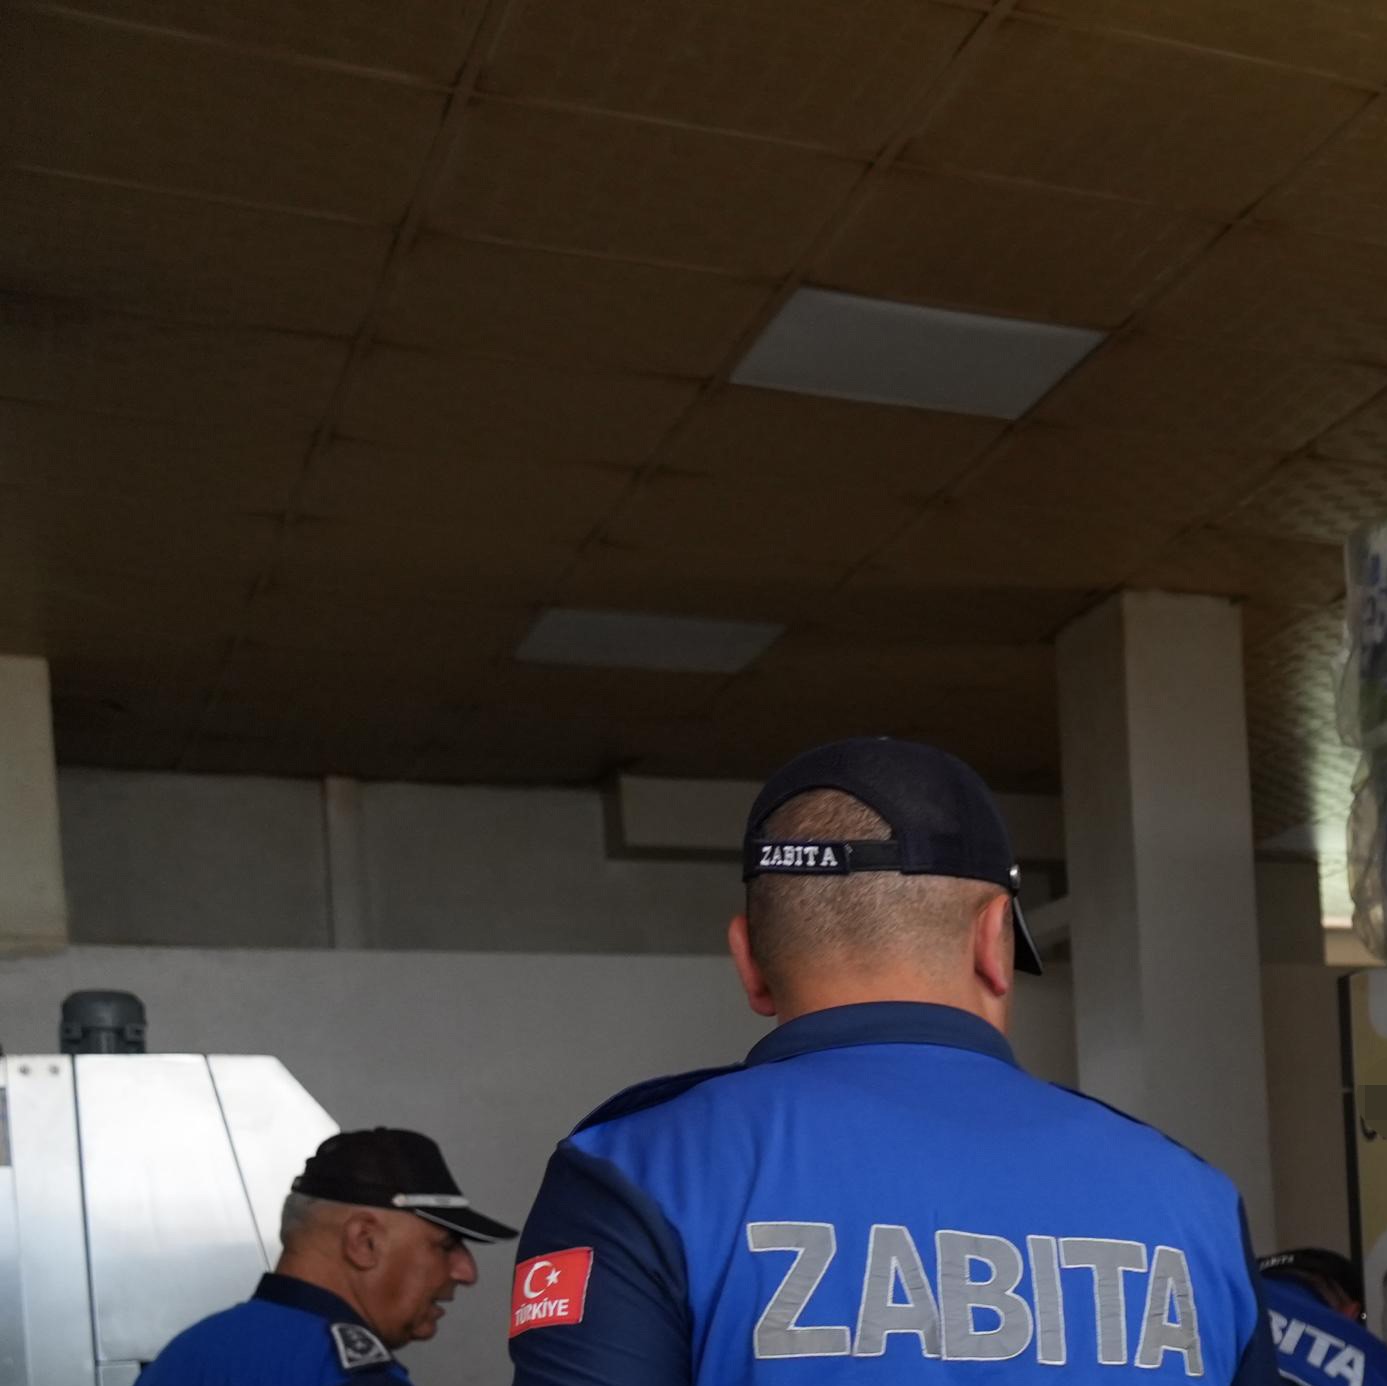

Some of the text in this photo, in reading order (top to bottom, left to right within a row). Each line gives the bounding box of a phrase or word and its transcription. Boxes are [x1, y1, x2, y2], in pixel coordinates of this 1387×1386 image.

[760, 846, 838, 867] ZABITA
[514, 1295, 570, 1328] TÜRKİYE
[747, 1220, 1204, 1377] ZABITA
